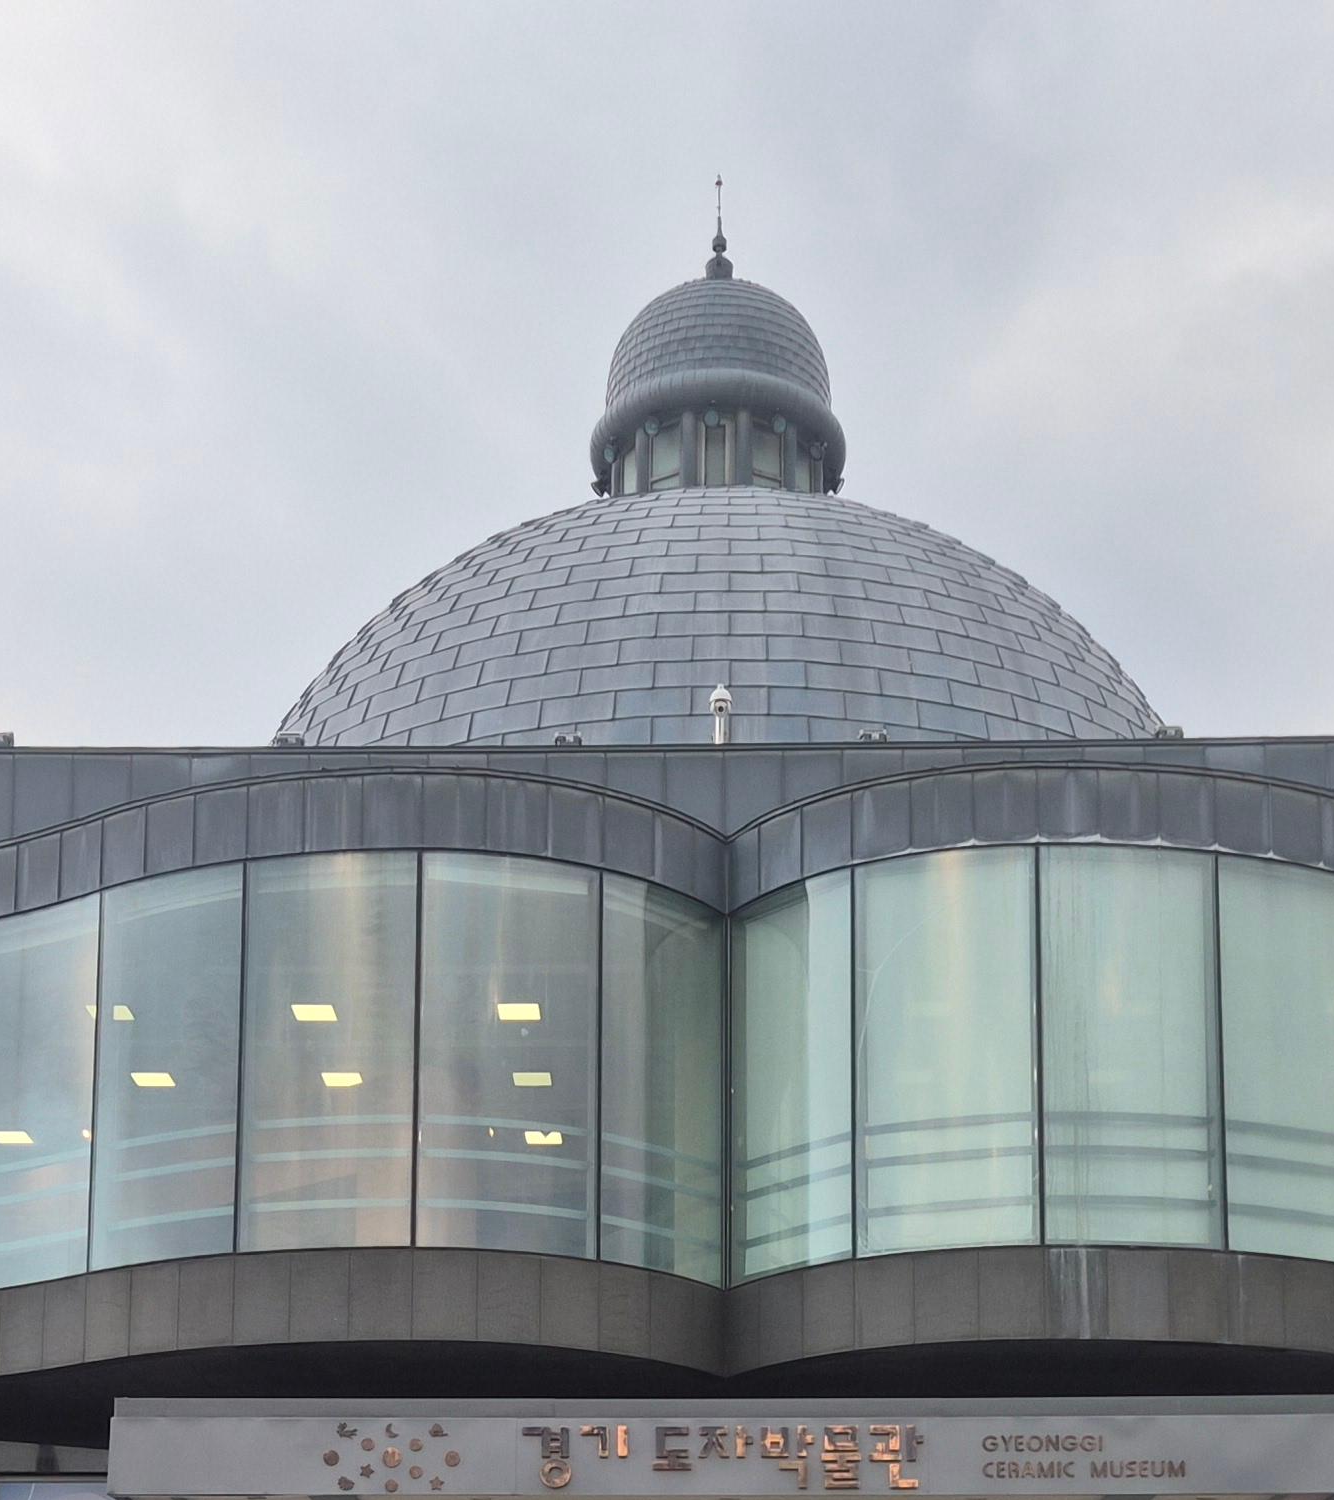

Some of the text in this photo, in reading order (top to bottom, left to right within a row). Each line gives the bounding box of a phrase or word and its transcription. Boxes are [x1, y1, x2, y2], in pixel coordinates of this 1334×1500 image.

[981, 1434, 1104, 1453] GYEONGGI
[522, 1423, 925, 1490] 경기 도자박물관
[981, 1459, 1187, 1480] CERAMIC MUSEUM
